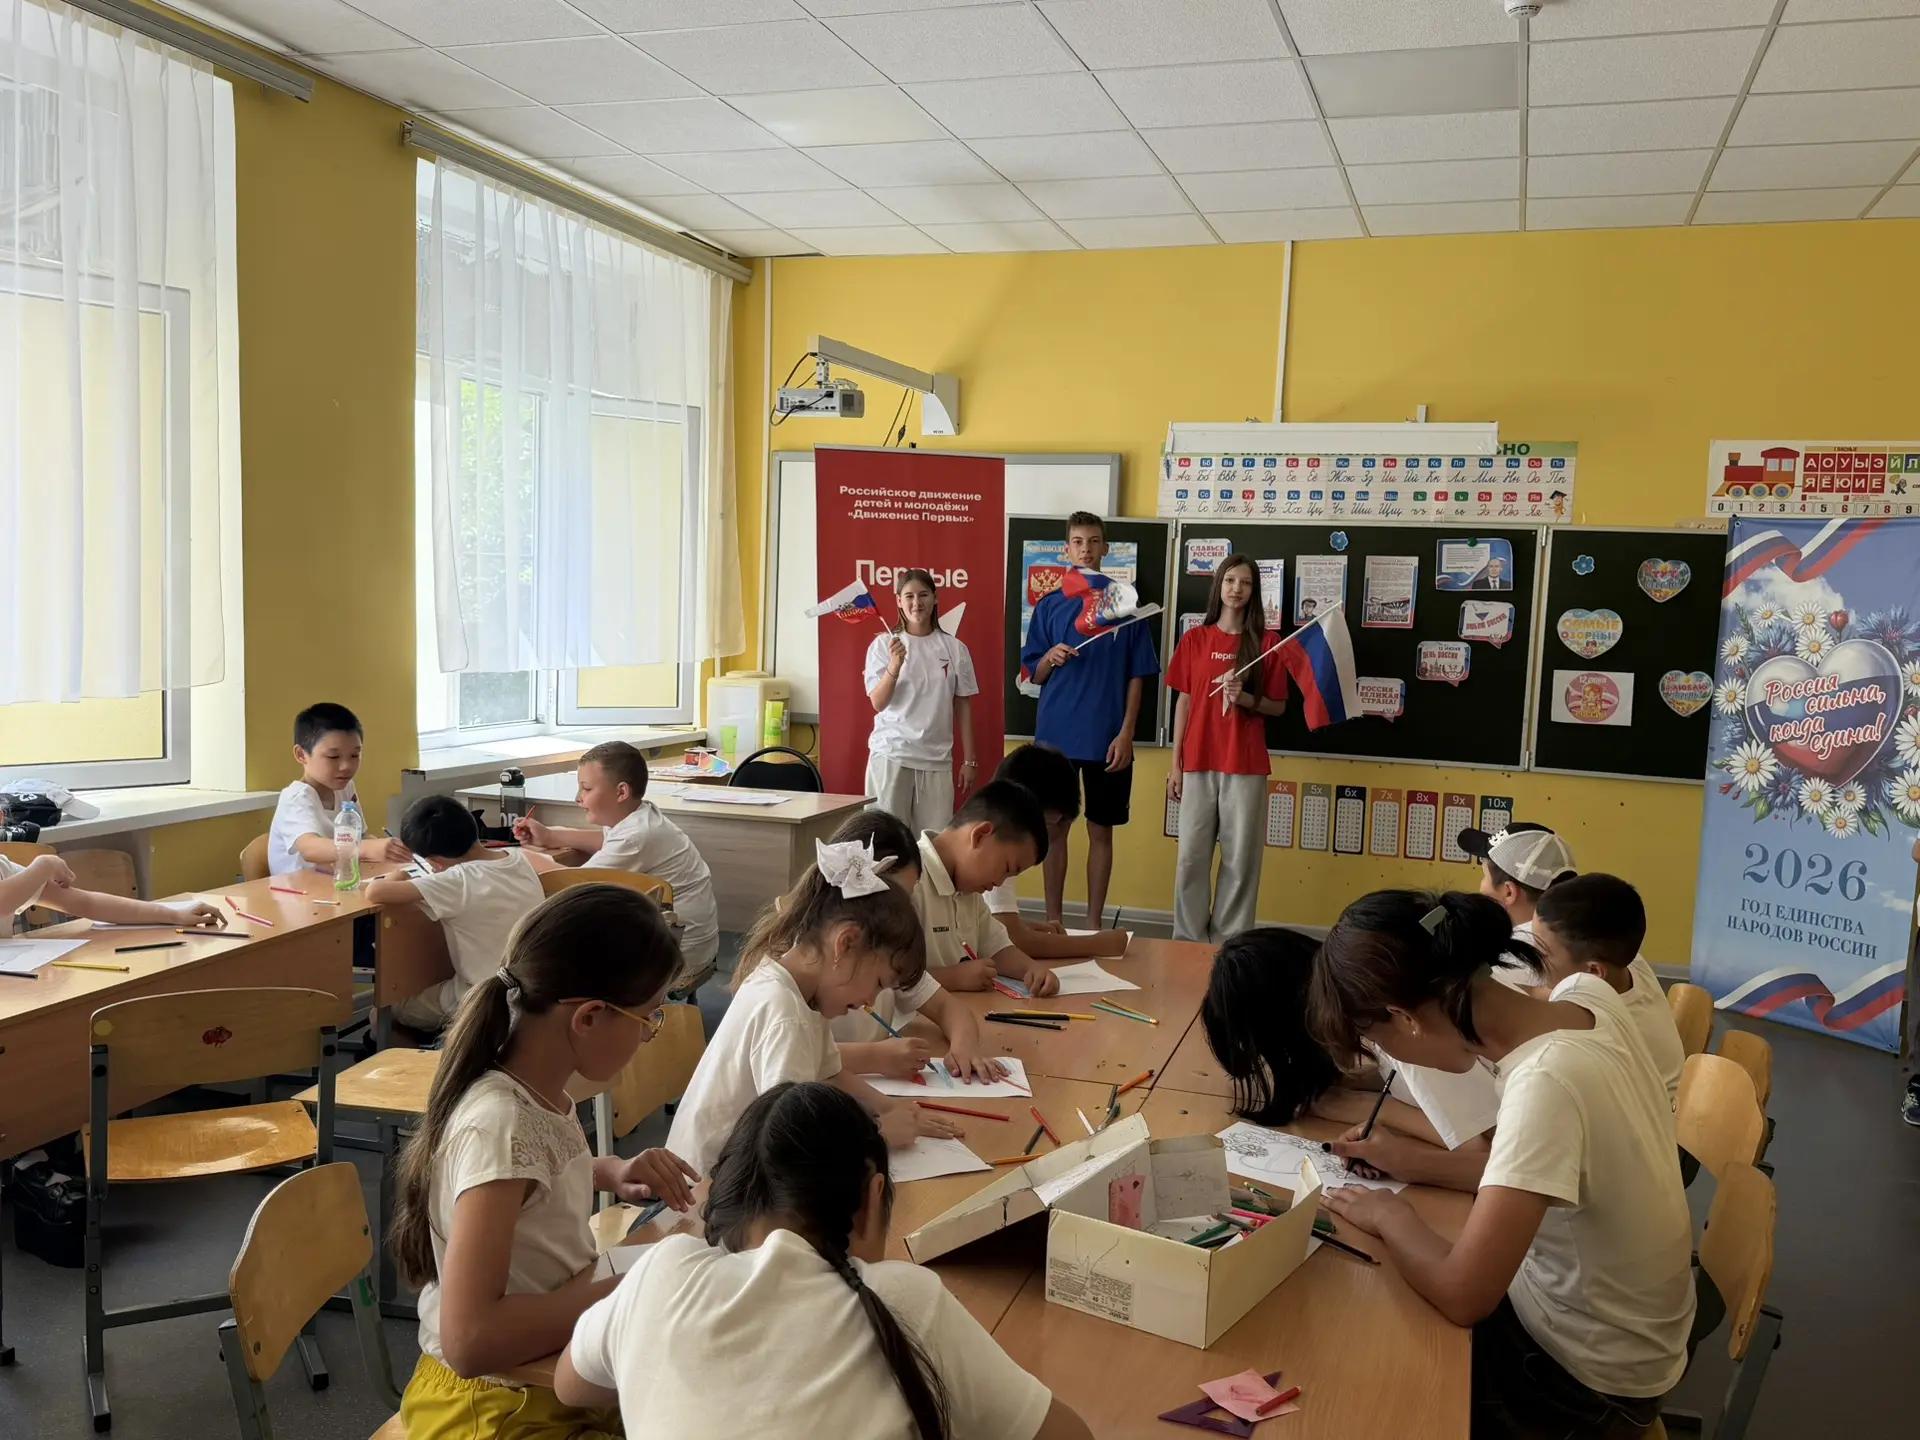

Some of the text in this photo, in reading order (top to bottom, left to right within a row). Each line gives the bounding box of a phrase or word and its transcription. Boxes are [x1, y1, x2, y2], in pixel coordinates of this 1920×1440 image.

[1806, 456, 1918, 468] А О У Ы Э Й Л
[839, 486, 982, 501] Российское движение
[1804, 476, 1882, 488] Я Ё Ю И Е
[848, 510, 974, 523] «Движение Первых»
[854, 499, 892, 510] детей
[904, 500, 969, 512] молодёжи
[1718, 503, 1724, 511] 0
[1758, 504, 1764, 512] 2
[1779, 504, 1785, 512] 3
[1800, 504, 1806, 512] 4
[1820, 504, 1827, 512] 5
[1863, 505, 1870, 513] 7
[1884, 505, 1890, 514] 8
[1906, 506, 1912, 514] 9
[855, 559, 969, 594] Перые
[1765, 674, 1838, 706] Россия
[1806, 683, 1887, 714] сильна,
[1770, 712, 1825, 745] когда
[1810, 713, 1886, 760] едина!
[1743, 843, 1868, 902] 2026
[1741, 898, 1865, 936] ГОД ЕДИНСТВА
[1727, 915, 1878, 960] НАРОДОВ РОССИИ
